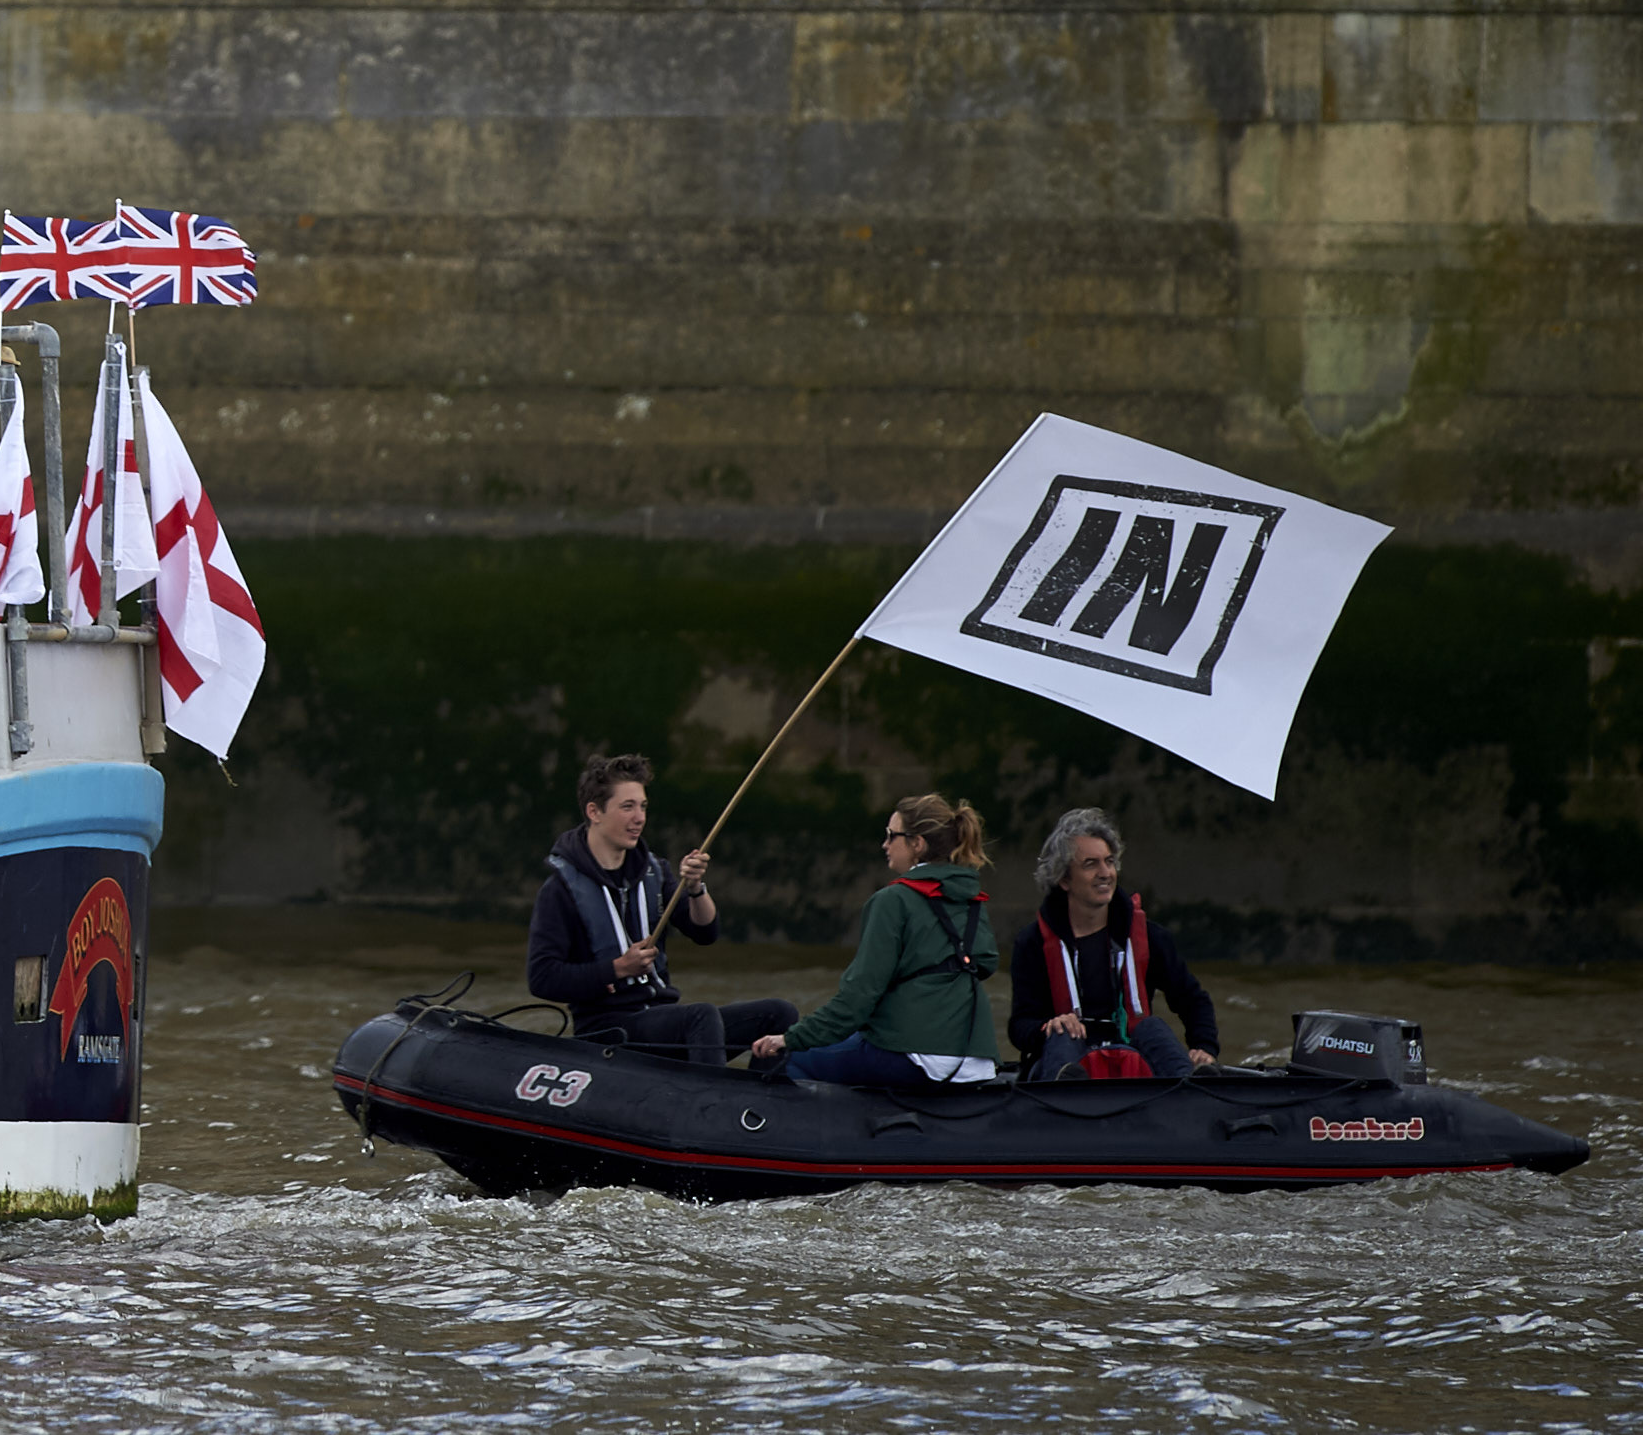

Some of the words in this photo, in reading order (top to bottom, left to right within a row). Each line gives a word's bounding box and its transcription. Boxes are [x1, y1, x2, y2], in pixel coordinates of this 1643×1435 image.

[1018, 506, 1229, 657] IN
[72, 903, 96, 970] BOY
[1319, 1033, 1376, 1055] TOHATSU
[515, 1063, 593, 1108] C3
[1309, 1116, 1426, 1142] Bombard
